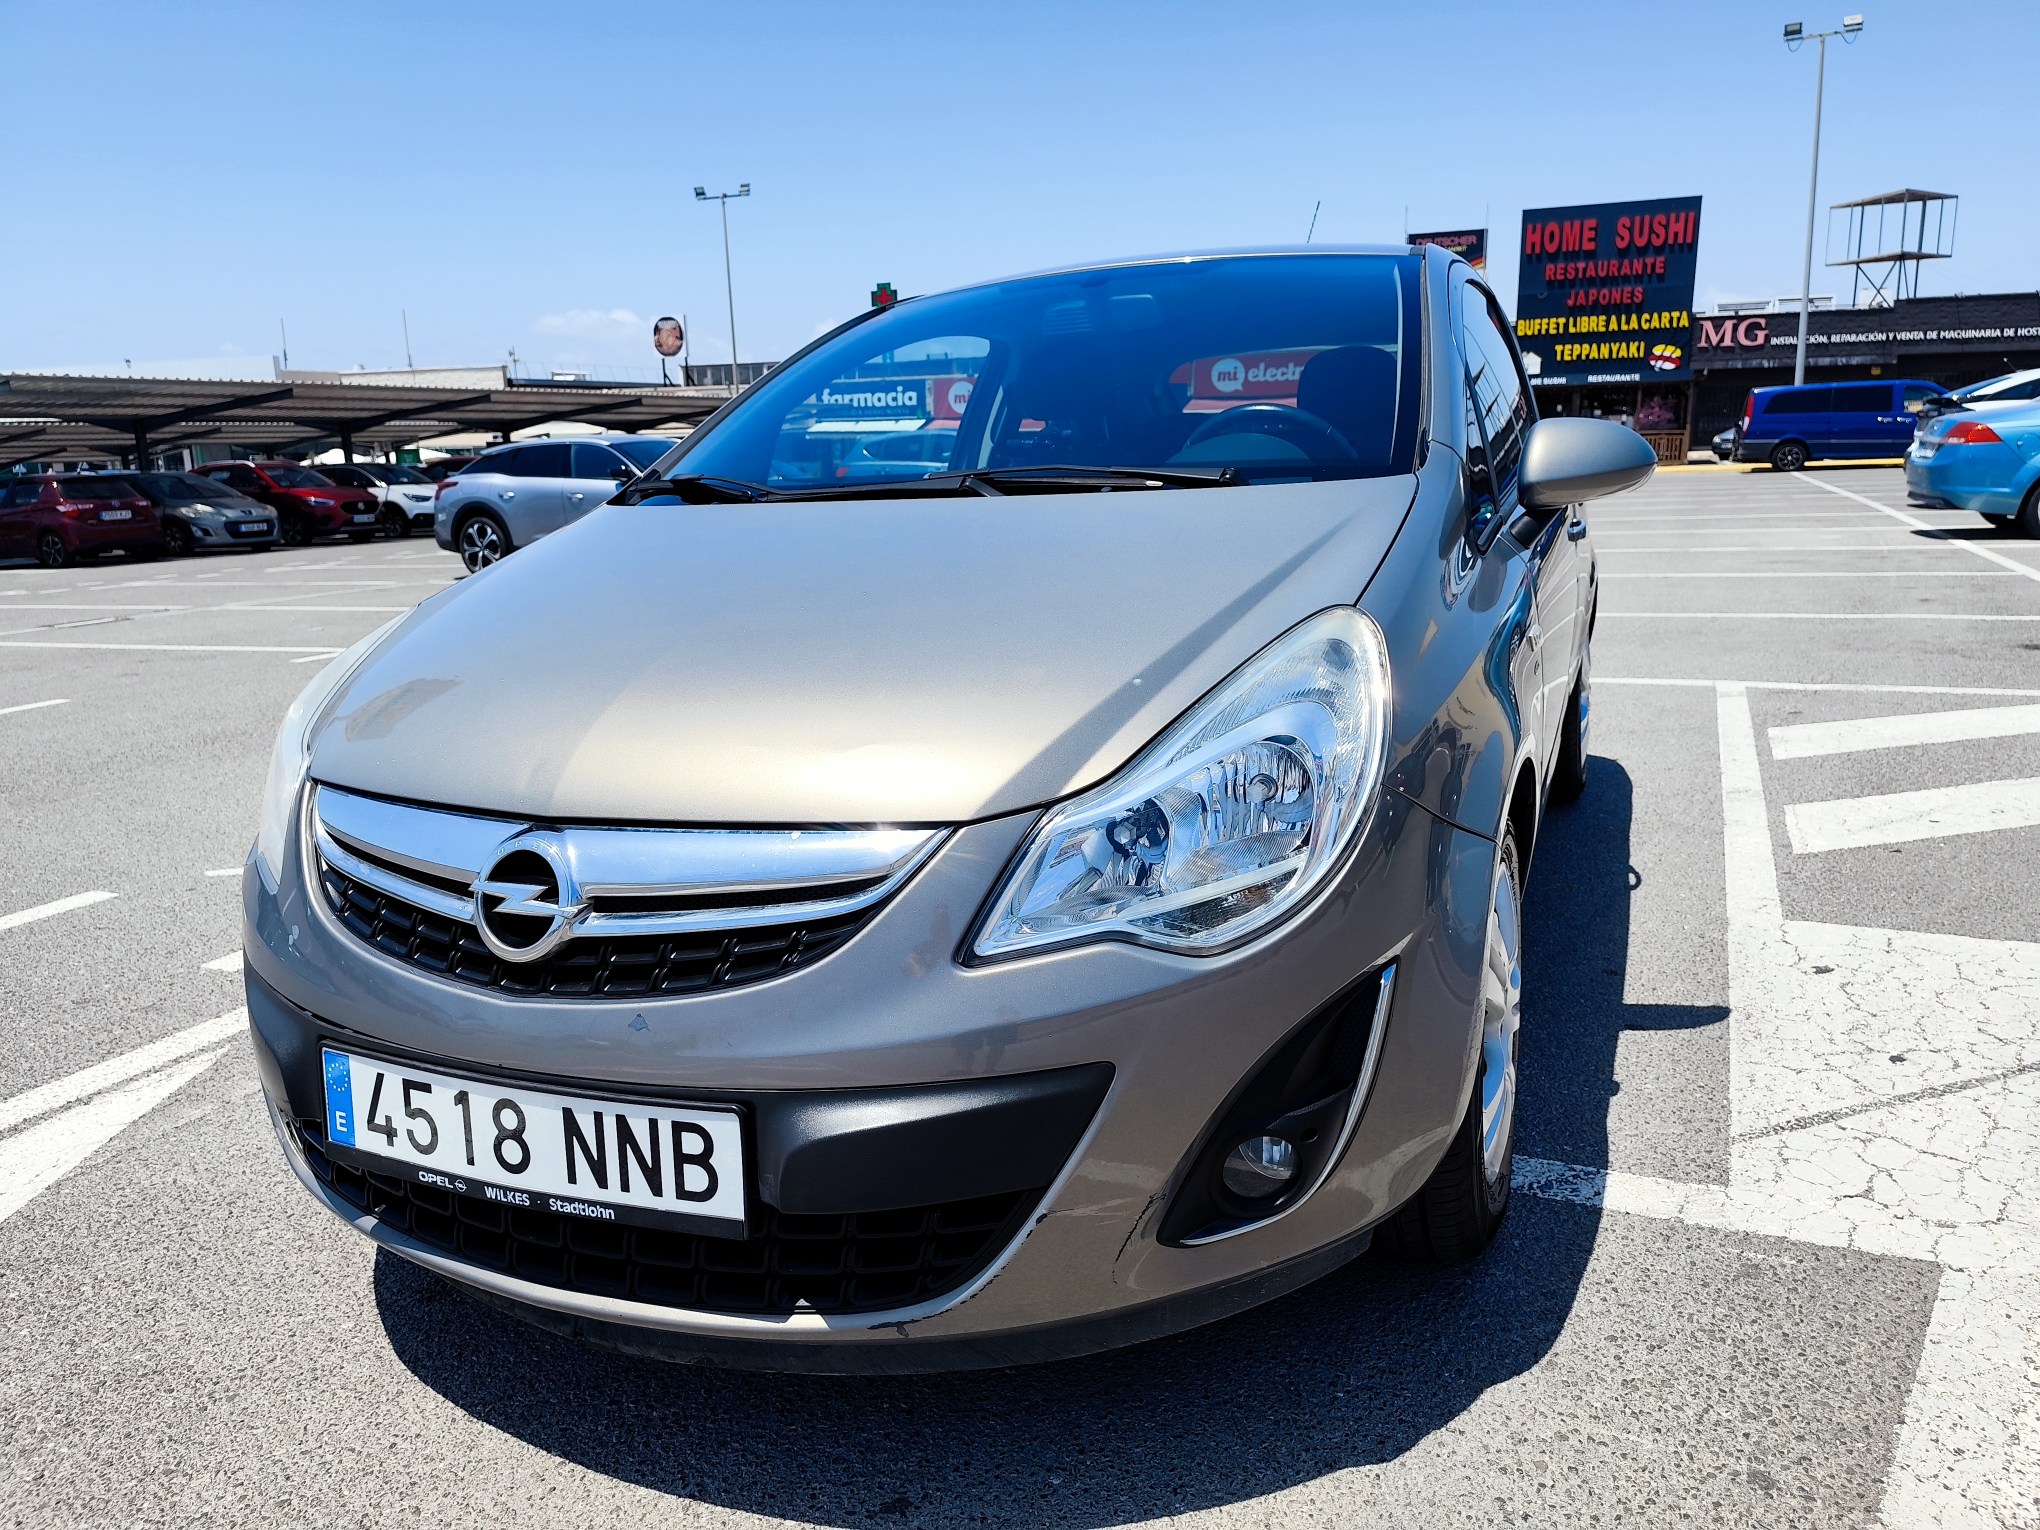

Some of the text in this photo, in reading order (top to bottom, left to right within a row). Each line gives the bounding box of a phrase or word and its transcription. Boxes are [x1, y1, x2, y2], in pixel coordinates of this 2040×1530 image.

[1525, 211, 1696, 255] HOME SUSHI
[1544, 256, 1666, 281] RESTAURANTE
[1566, 287, 1645, 308] JAPONES
[1517, 310, 1690, 337] BUFFET LIBRE A LA CARTA
[1697, 317, 1770, 348] MG
[1770, 332, 1829, 346] INSTALCIÓN,
[1888, 331, 1895, 342] Y
[1895, 330, 1925, 341] VENTA
[1926, 330, 1938, 340] DE
[1940, 328, 2001, 340] MAQUINARIA
[2003, 327, 2016, 338] DE
[1554, 341, 1646, 362] TEPPANYAKI
[1217, 365, 1239, 382] mi
[1587, 373, 1641, 383] RESTAURANTE
[821, 385, 918, 408] farmacia
[335, 1072, 719, 1203] E 4518 NNB
[418, 1170, 615, 1221] OPEL WILKES Stadtlohn
